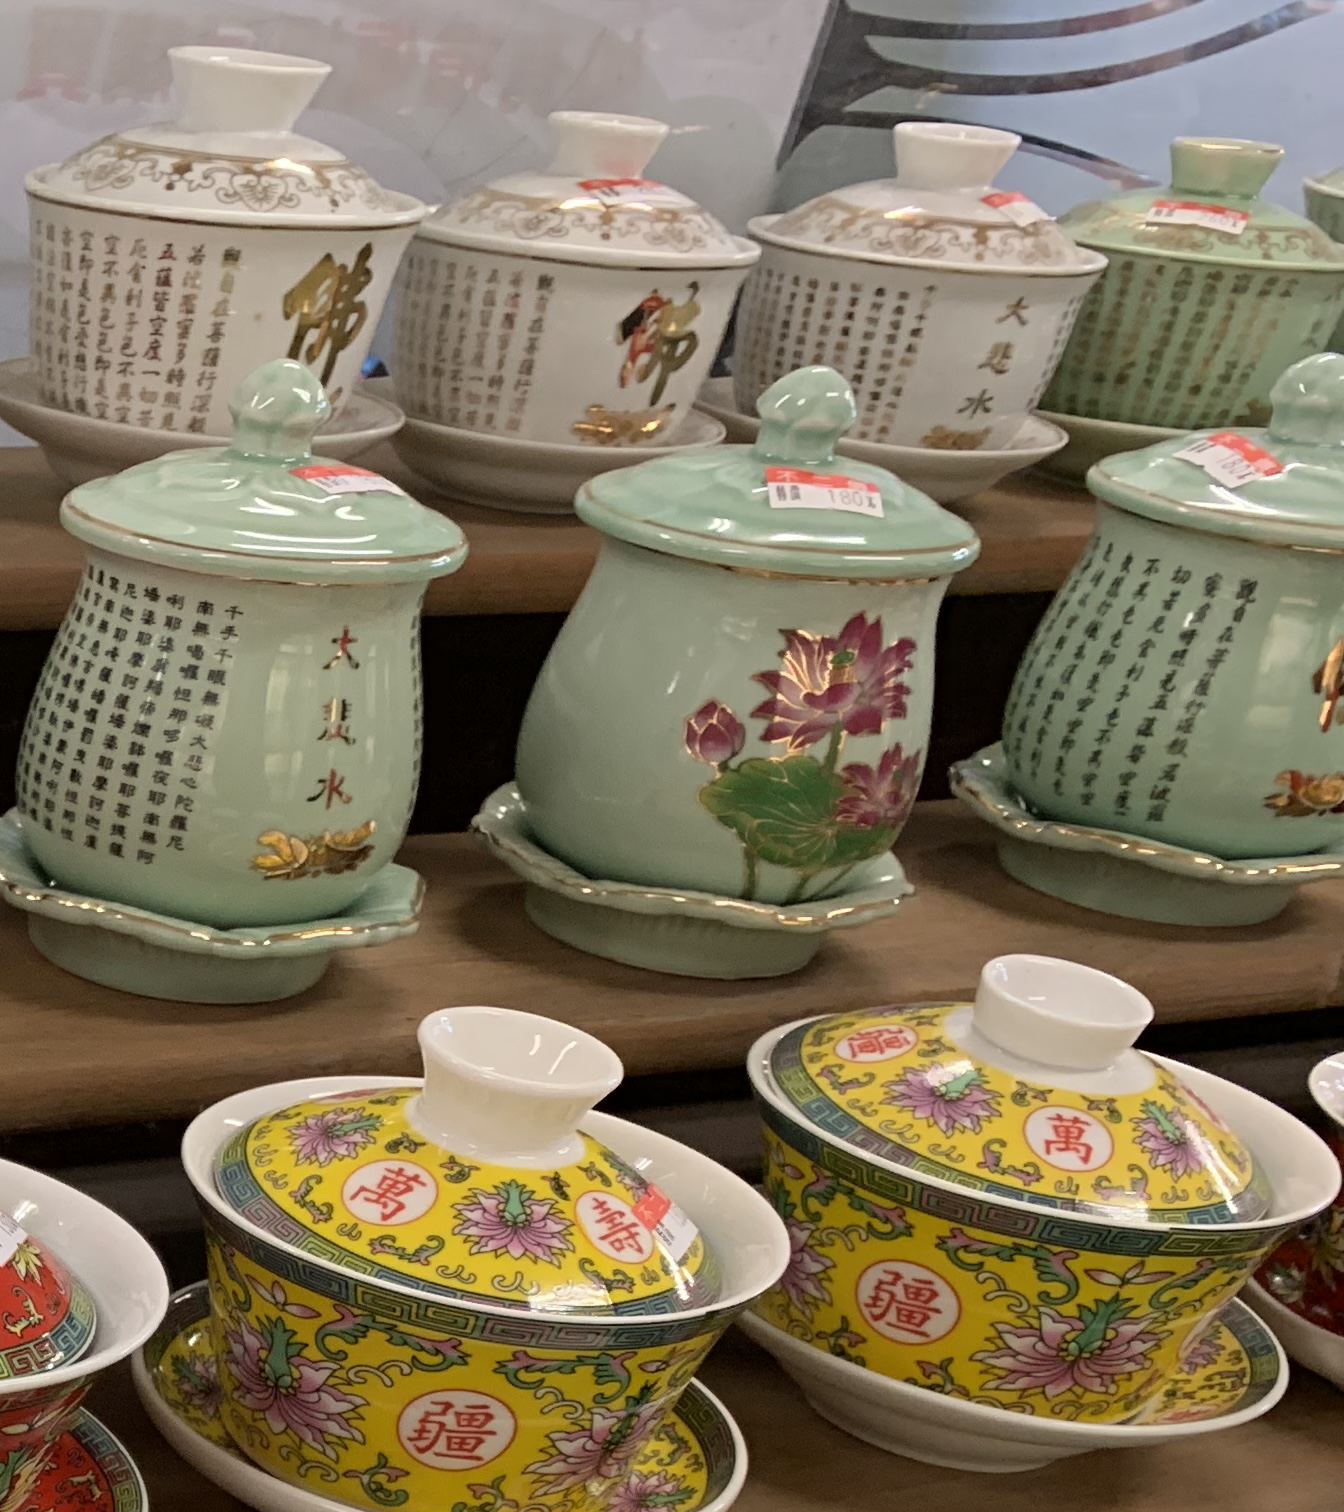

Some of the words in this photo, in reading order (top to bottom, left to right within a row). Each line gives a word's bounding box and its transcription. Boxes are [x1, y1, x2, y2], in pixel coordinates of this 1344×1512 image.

[957, 296, 1030, 418] 大悲水
[306, 624, 361, 811] 大悲水
[1043, 1113, 1096, 1164] 萬
[348, 1166, 428, 1221] 萬
[863, 1269, 944, 1339] 疆
[406, 1401, 499, 1462] 疆
